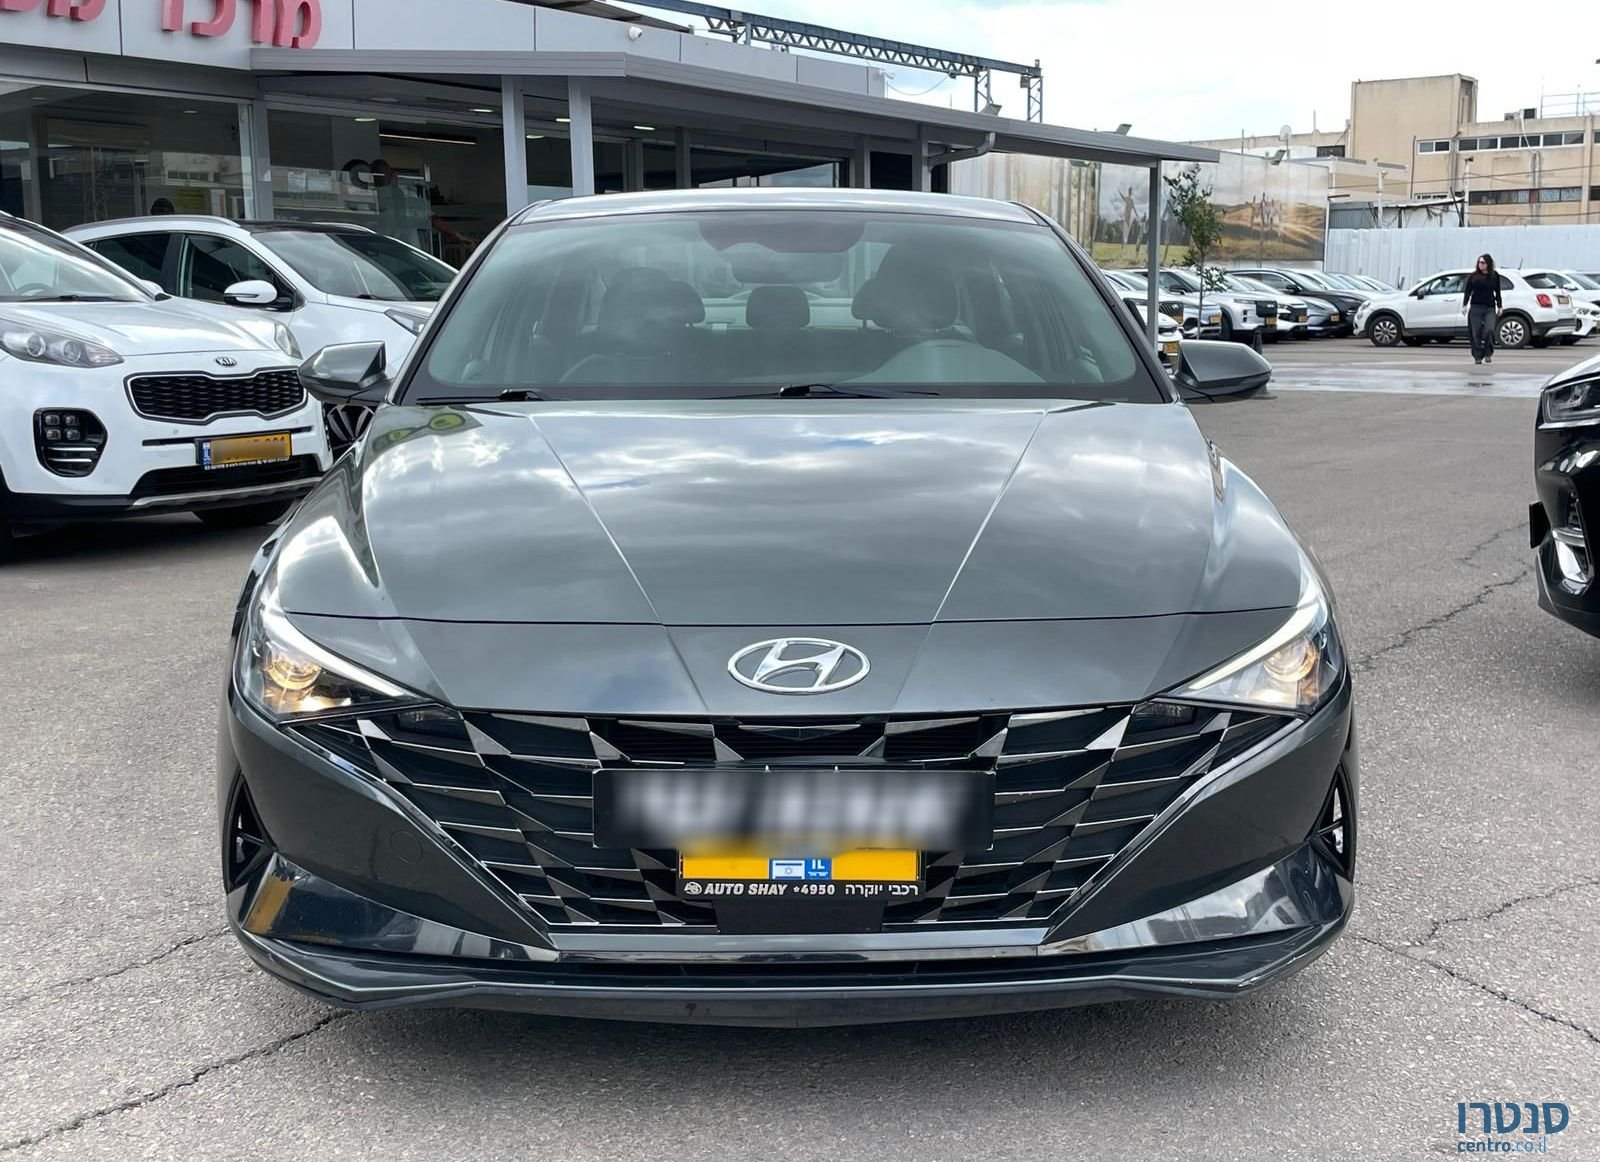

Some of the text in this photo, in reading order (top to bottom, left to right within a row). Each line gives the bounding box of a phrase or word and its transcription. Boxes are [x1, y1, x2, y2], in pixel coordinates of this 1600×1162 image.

[811, 859, 826, 870] IL
[704, 883, 744, 895] AUTO
[748, 883, 788, 896] SHAY
[845, 884, 883, 898] יוקרה
[888, 884, 919, 896] רכבי
